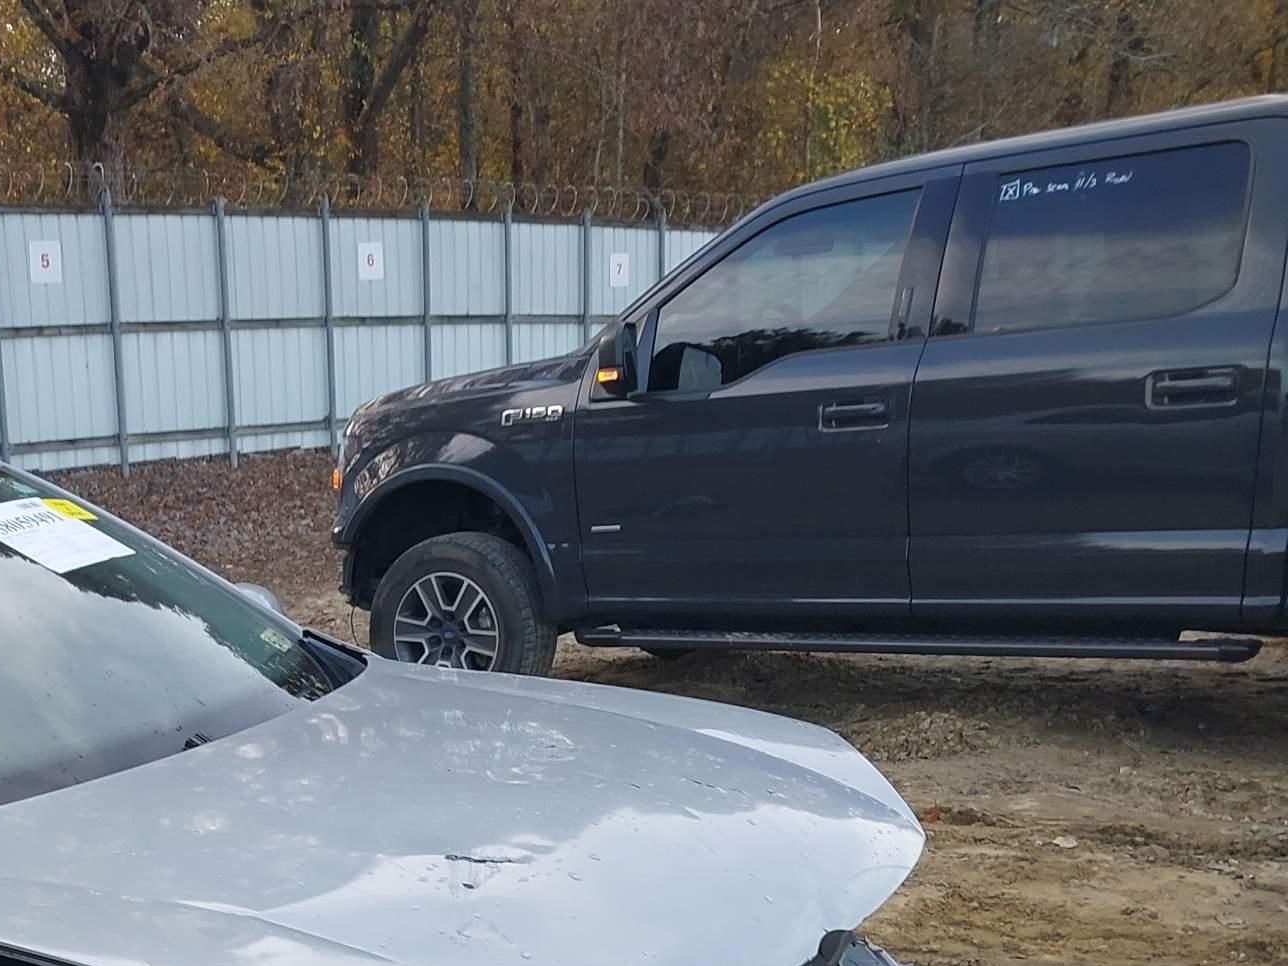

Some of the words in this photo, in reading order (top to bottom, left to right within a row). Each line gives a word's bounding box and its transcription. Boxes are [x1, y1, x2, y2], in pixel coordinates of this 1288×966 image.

[40, 253, 50, 268] 5
[367, 254, 375, 267] 6
[616, 264, 623, 276] 7
